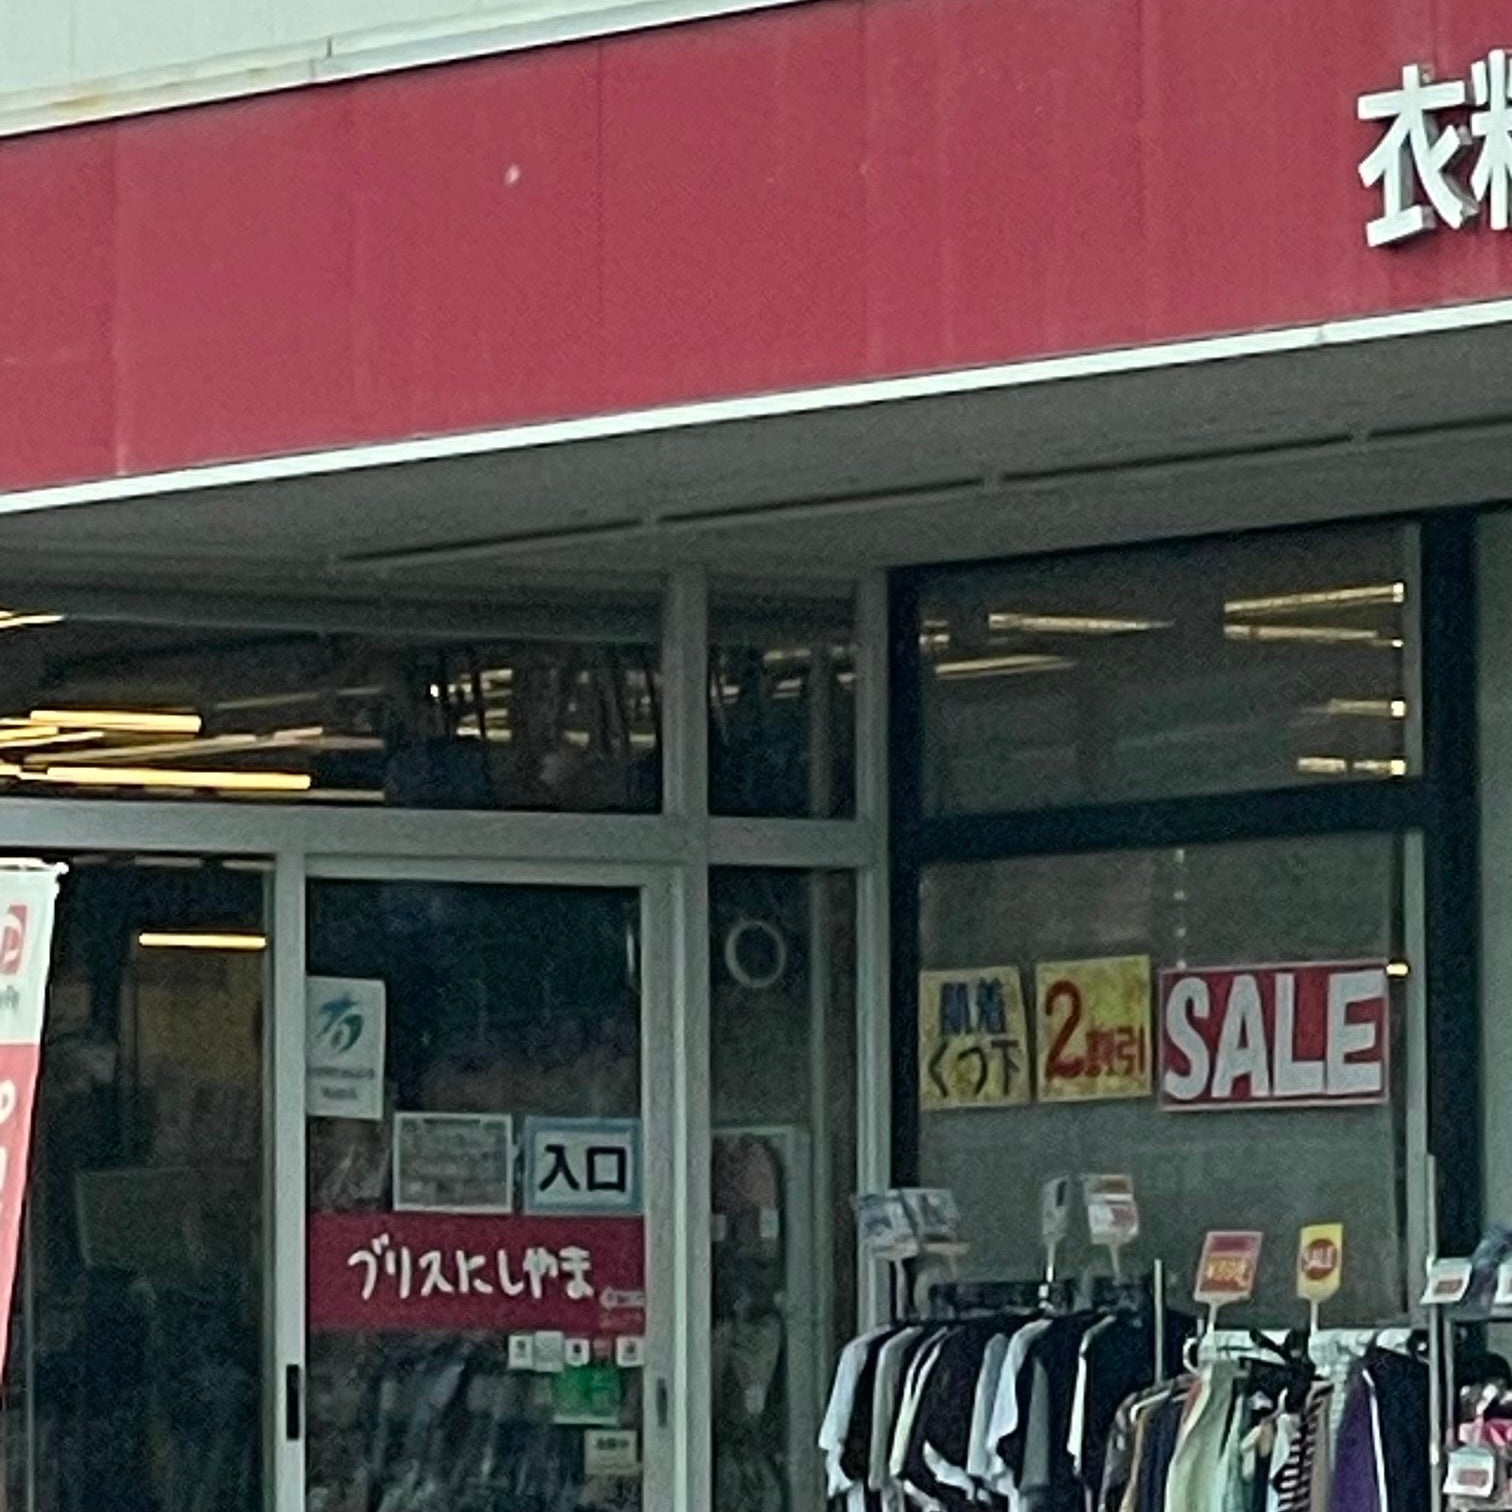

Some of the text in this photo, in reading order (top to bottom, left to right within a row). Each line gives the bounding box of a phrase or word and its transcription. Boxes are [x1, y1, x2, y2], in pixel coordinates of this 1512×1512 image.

[1164, 969, 1387, 1100] SALE
[538, 1143, 627, 1194] 入口
[347, 1232, 595, 1300] ブリスにしやま
